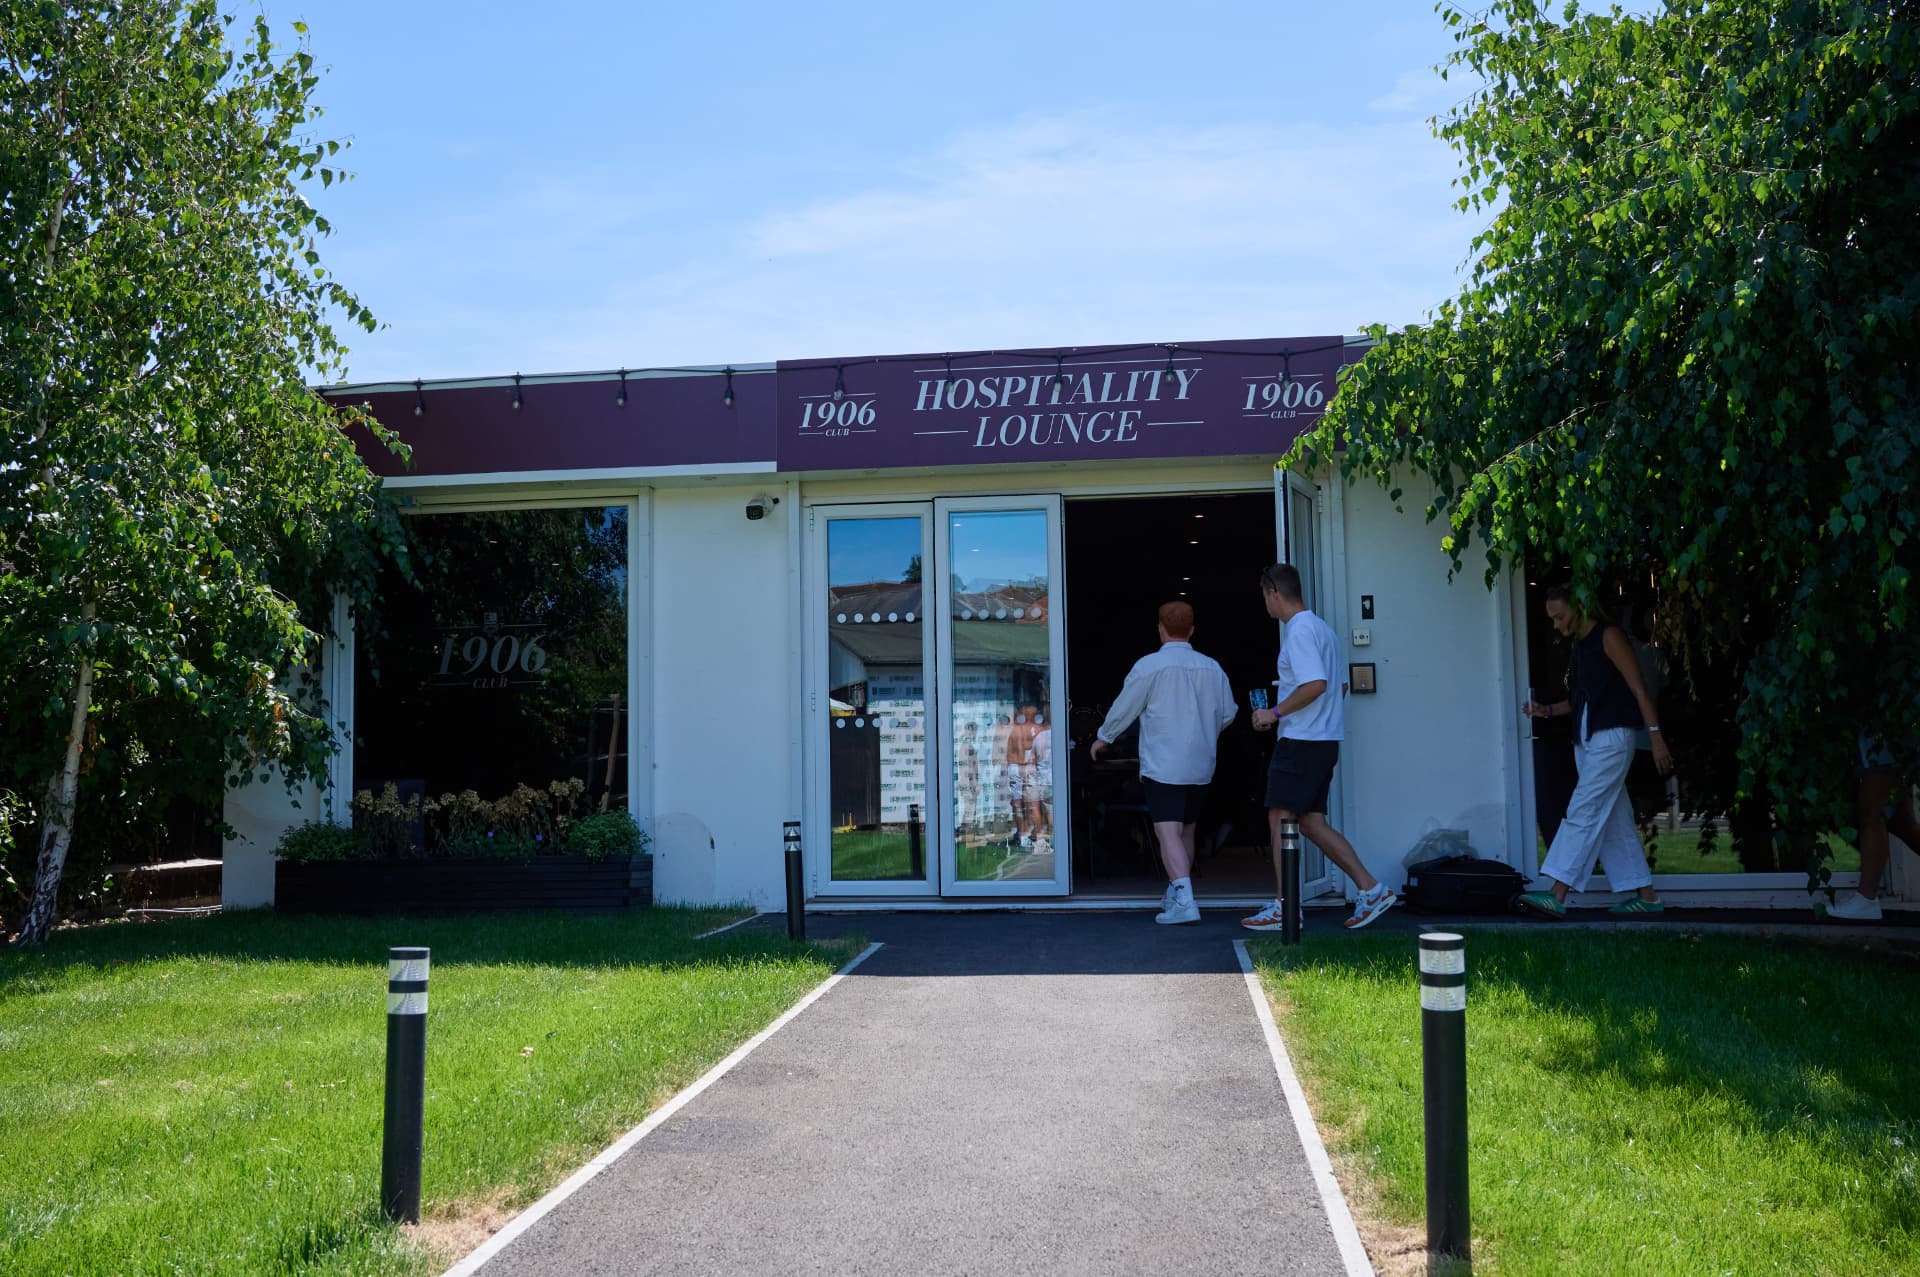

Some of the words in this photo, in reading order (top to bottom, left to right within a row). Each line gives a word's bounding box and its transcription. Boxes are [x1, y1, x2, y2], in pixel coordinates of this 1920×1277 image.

[913, 368, 1201, 411] HOSPITALITY
[1241, 380, 1325, 410] 1906
[799, 400, 877, 428] 1906
[973, 410, 1142, 447] LOUNGE
[1270, 410, 1296, 419] CLUB
[825, 428, 850, 437] CLUB
[432, 634, 547, 675] 1906
[473, 677, 508, 689] CLUB
